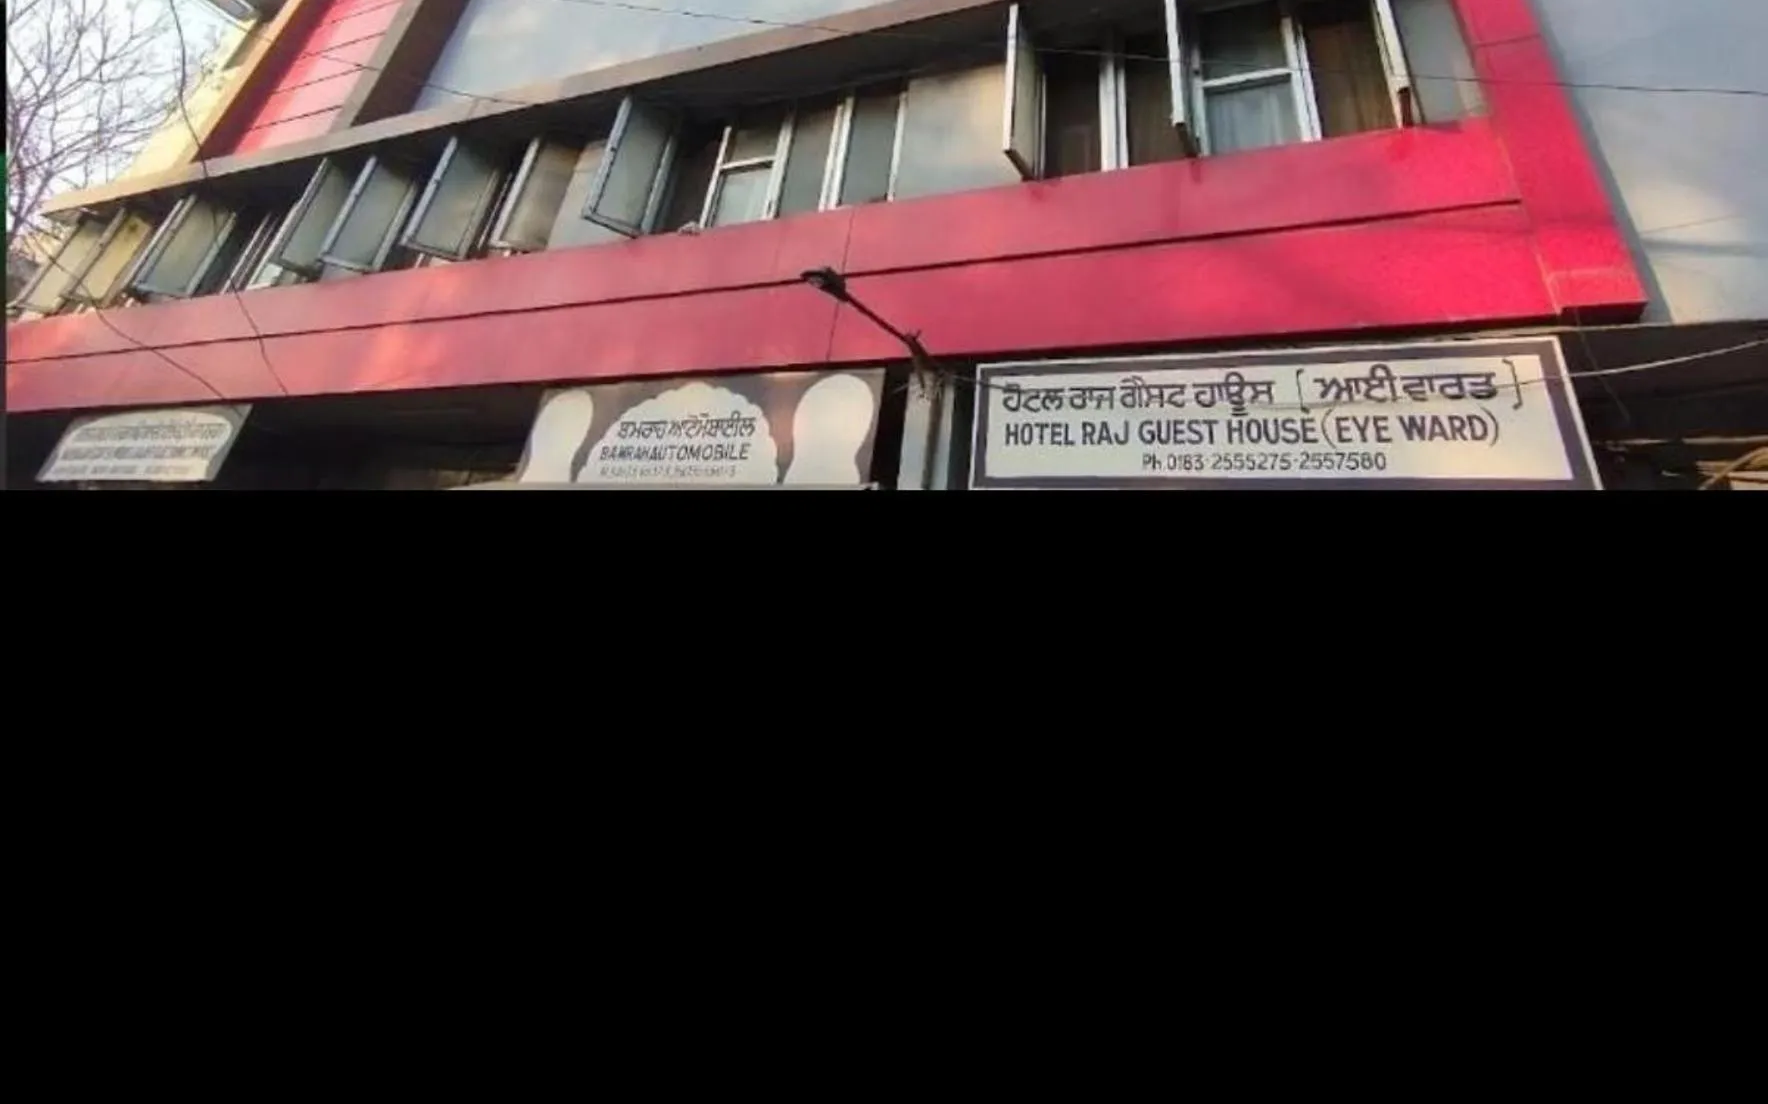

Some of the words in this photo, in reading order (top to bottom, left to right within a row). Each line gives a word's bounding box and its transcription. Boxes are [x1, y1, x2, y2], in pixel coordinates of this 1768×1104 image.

[1069, 385, 1117, 410] ਰਾਜ
[1192, 371, 1275, 417] ਹਾਊਸ
[1005, 421, 1075, 446] HOTEL
[1081, 420, 1130, 446] RAJ
[1138, 419, 1219, 445] GUEST
[1227, 416, 1319, 445] HOUSE
